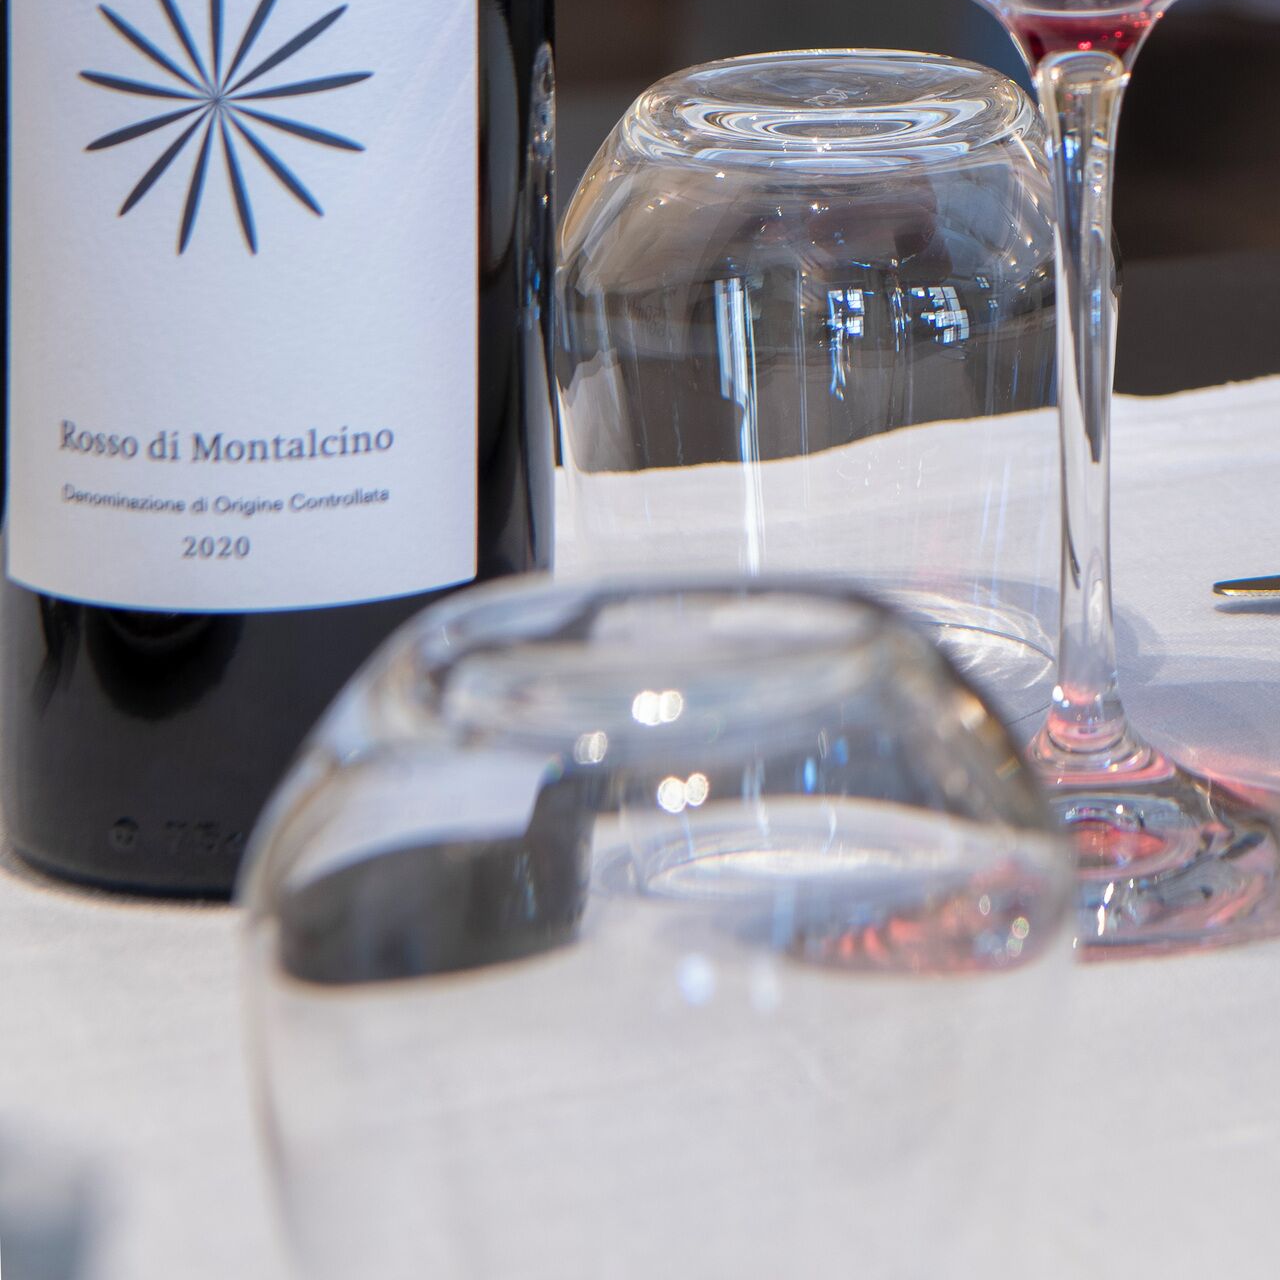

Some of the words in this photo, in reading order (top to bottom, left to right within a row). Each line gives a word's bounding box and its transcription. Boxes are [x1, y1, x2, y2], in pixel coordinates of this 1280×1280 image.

[59, 420, 139, 459] Rosso
[148, 431, 180, 460] di
[191, 425, 394, 463] Montalcino
[62, 484, 186, 513] Denominazione
[194, 494, 209, 513] di
[214, 496, 283, 517] Origine
[289, 487, 390, 511] Controllata
[182, 536, 251, 559] 2020
